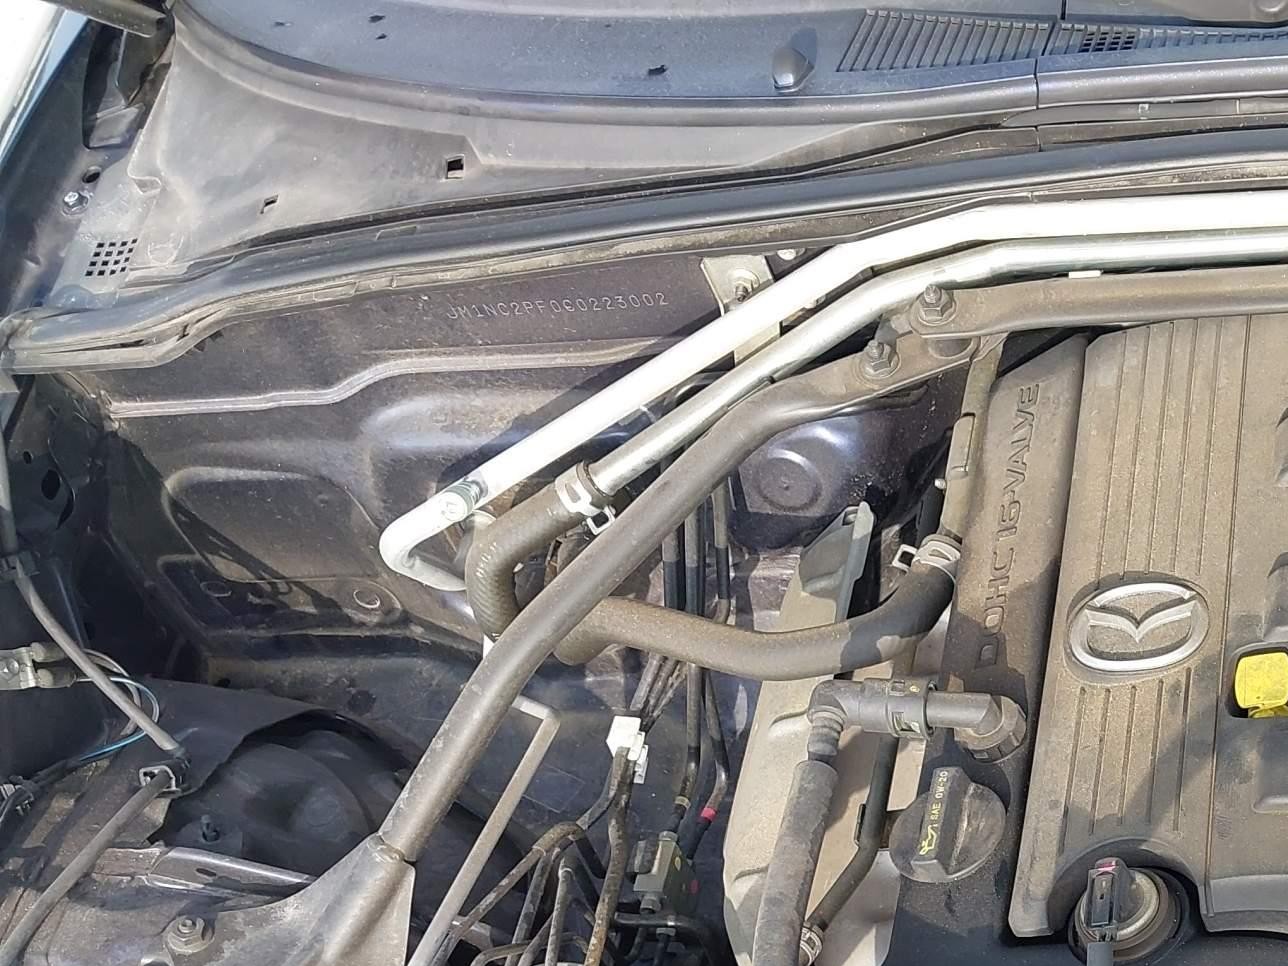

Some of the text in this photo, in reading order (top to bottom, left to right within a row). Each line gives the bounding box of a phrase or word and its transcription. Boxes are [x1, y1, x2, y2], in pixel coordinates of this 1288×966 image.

[974, 382, 1041, 673] DOHC 16-VALVE
[930, 802, 942, 820] SAE
